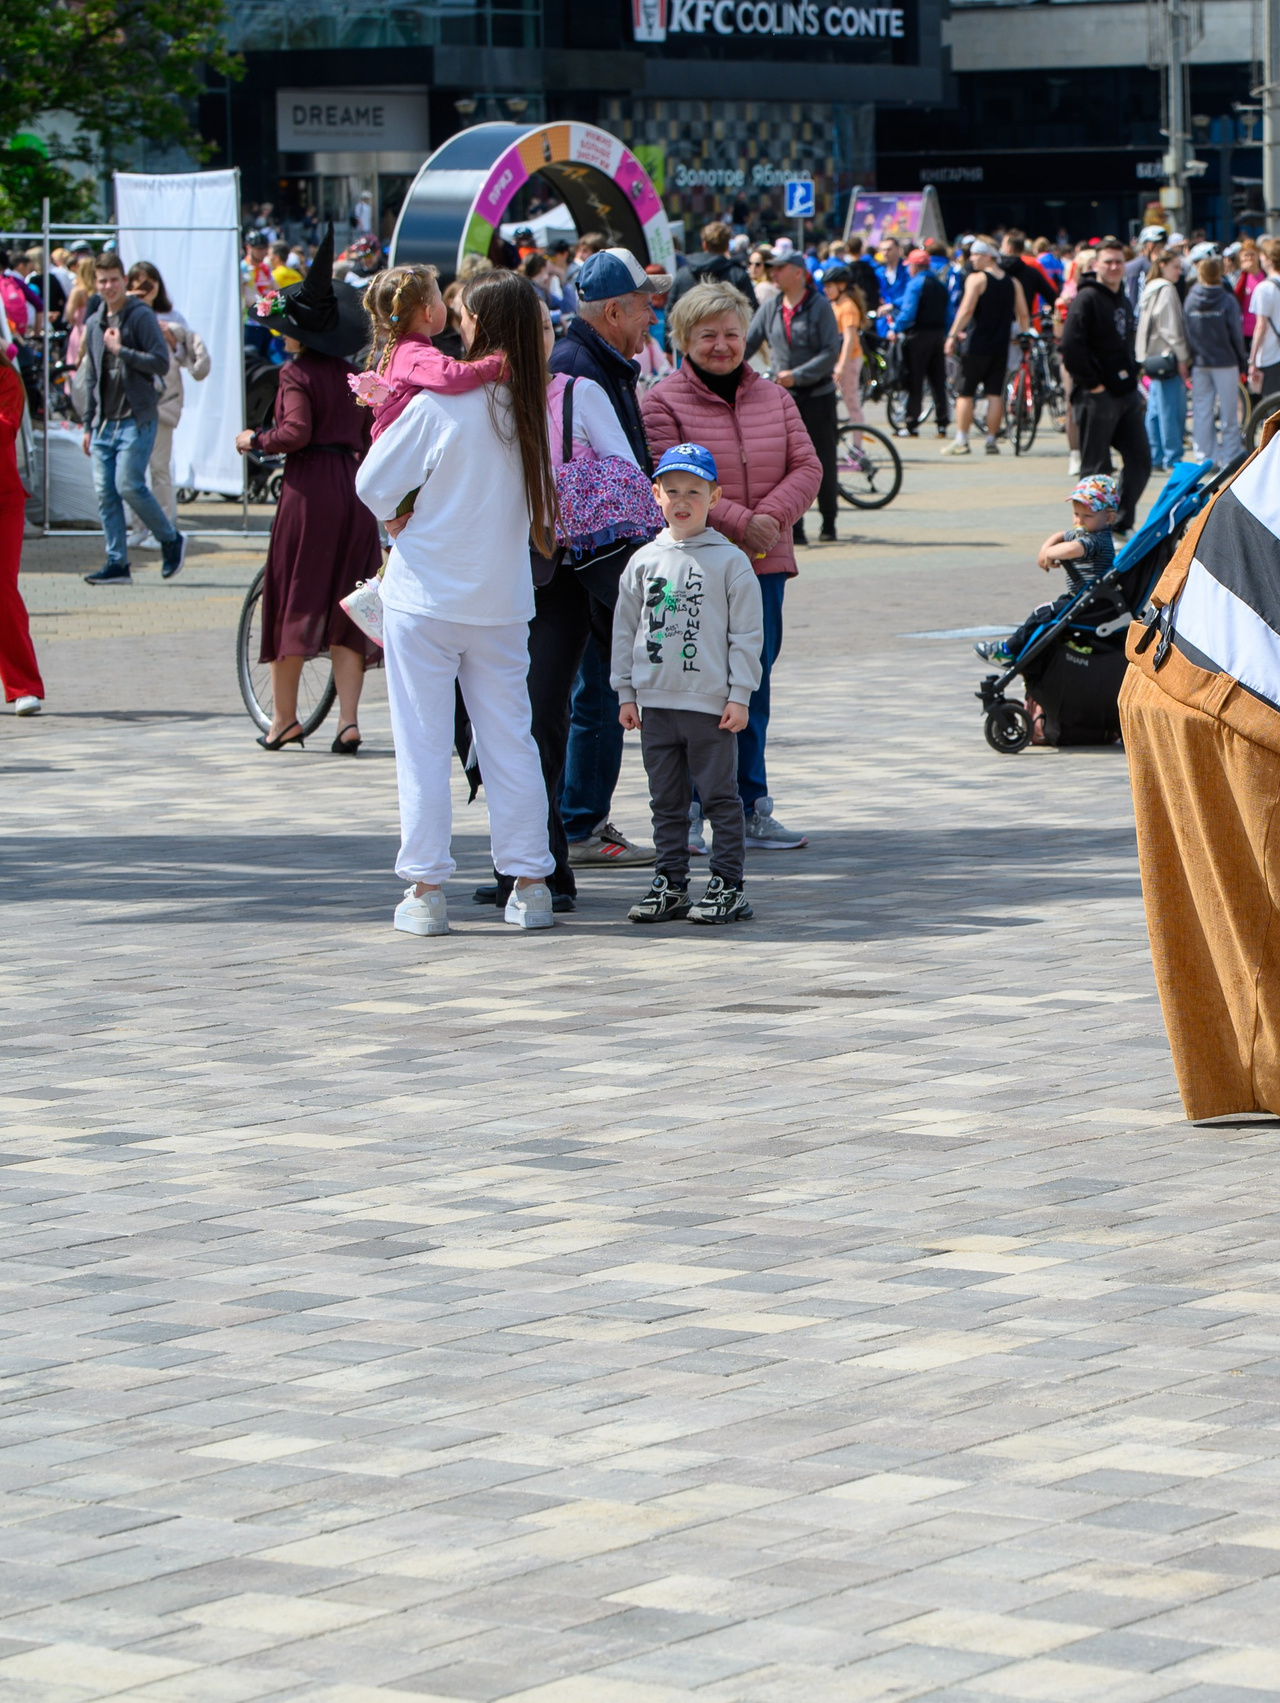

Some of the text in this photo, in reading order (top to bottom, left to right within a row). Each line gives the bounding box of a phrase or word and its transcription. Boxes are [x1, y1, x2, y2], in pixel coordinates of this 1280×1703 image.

[669, 0, 905, 38] KFC COLIN'S CONTE
[292, 104, 385, 127] DREAME
[487, 168, 513, 206] ПРИЗ
[675, 163, 745, 187] Золотое
[646, 576, 668, 664] NEW
[682, 566, 705, 673] FORECAST
